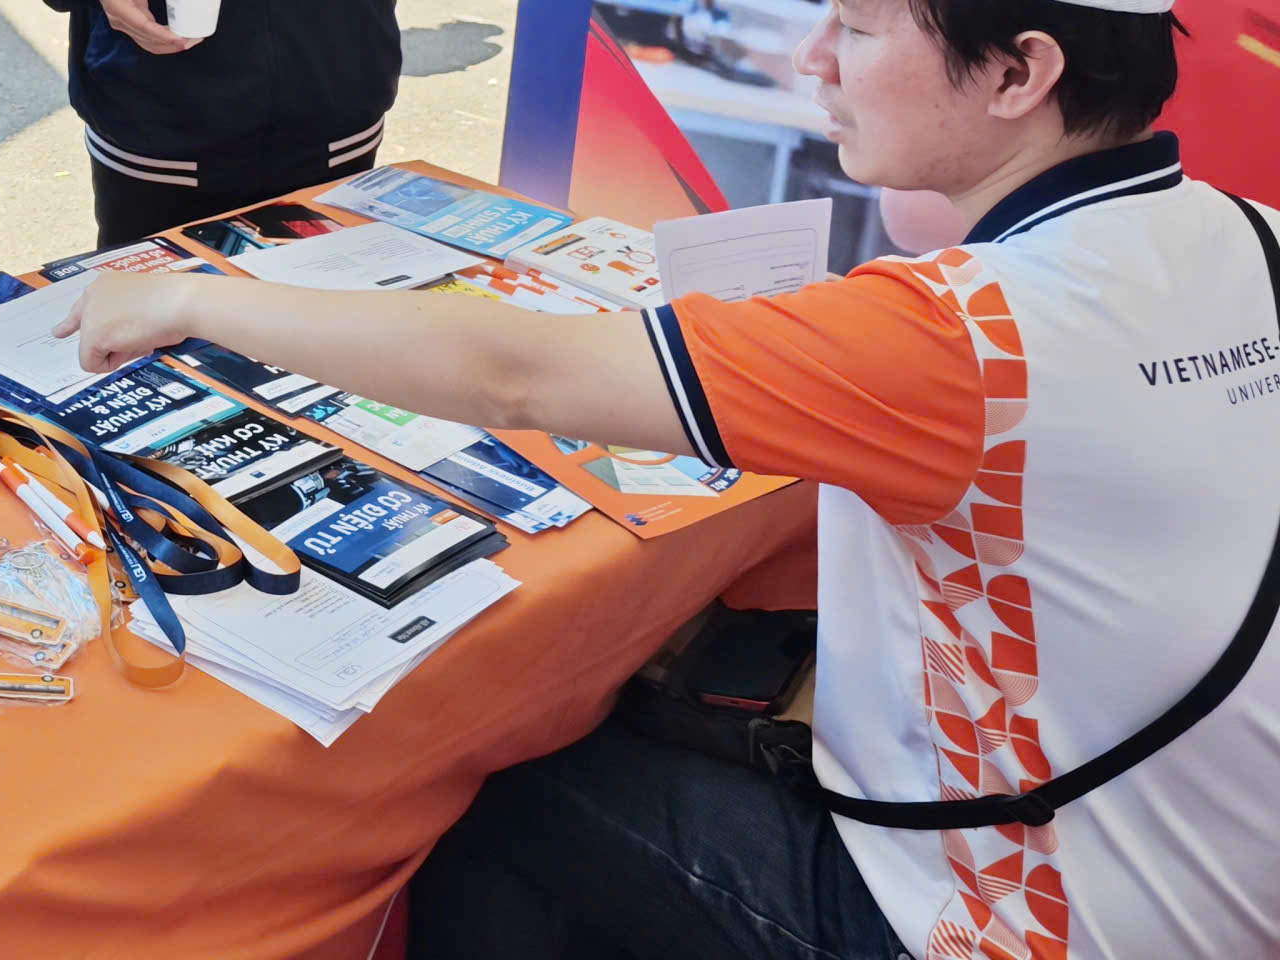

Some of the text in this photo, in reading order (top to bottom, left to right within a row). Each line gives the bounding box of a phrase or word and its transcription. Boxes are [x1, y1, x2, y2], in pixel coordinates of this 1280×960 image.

[96, 386, 154, 416] ĐIỆN &
[144, 395, 174, 418] KỸ
[89, 407, 145, 437] THUẬT
[195, 422, 265, 457] CƠ KHÍ
[192, 433, 289, 480] KỸ THUẬT
[303, 491, 413, 558] CƠ ĐIỆN TỬ
[382, 509, 418, 532] THUẬT
